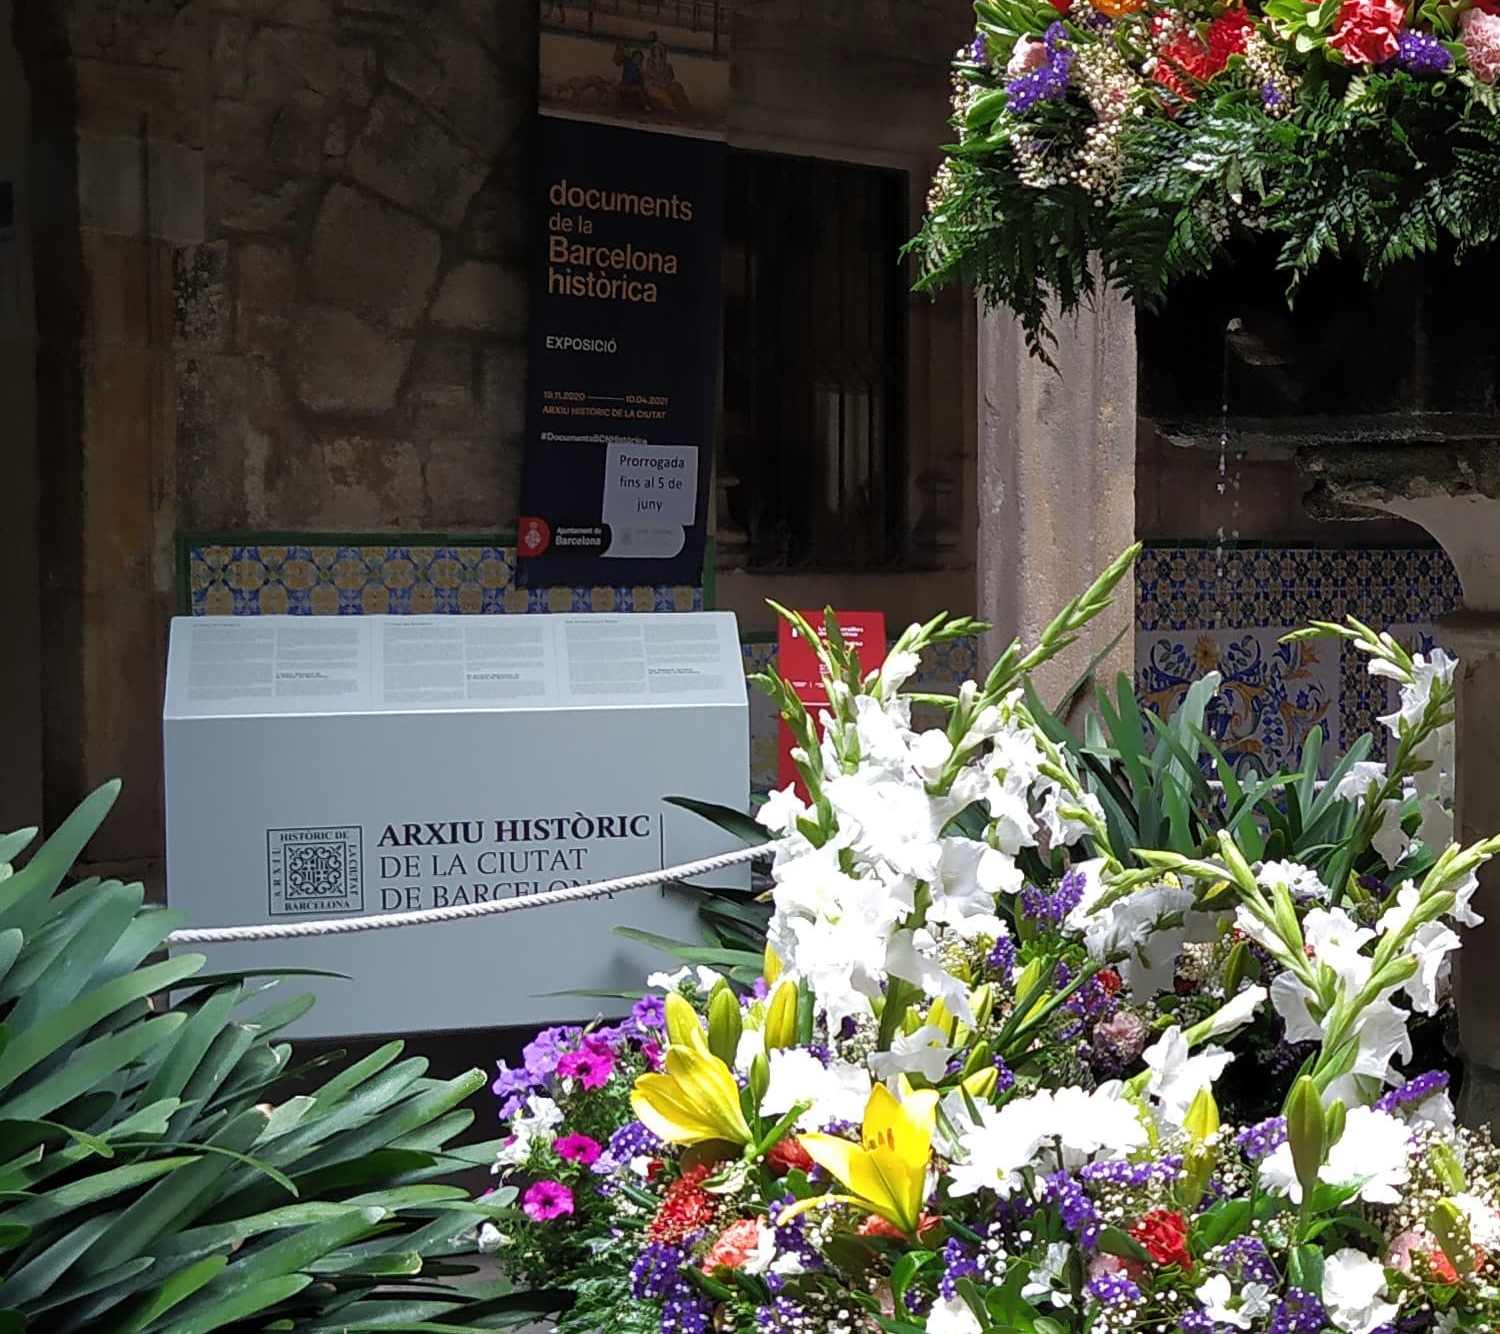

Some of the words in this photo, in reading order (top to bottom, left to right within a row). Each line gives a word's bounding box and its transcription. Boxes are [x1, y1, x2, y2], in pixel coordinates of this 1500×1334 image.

[549, 179, 693, 222] documents
[548, 212, 573, 233] de
[578, 215, 593, 234] la
[549, 235, 678, 275] Barcelona
[548, 266, 658, 303] històrica
[545, 335, 617, 354] EXPOSICIÓ
[542, 405, 570, 416] ARXIU
[612, 409, 623, 418] DE
[624, 409, 635, 418] LA
[636, 410, 667, 419] CIUTAT
[619, 454, 685, 471] Prorrogada
[619, 475, 641, 489] fins
[644, 476, 655, 489] al
[658, 477, 665, 489] 5
[668, 477, 683, 490] de
[637, 498, 663, 512] juny
[555, 535, 602, 546] Barcelona
[335, 830, 349, 840] DE
[378, 821, 484, 848] ARXIU
[494, 812, 651, 843] HISTÒRIC
[380, 855, 421, 879] DE
[432, 853, 468, 877] LA
[477, 848, 588, 875] CIUTAT
[285, 900, 350, 912] BARCELONA
[380, 886, 422, 911] DE
